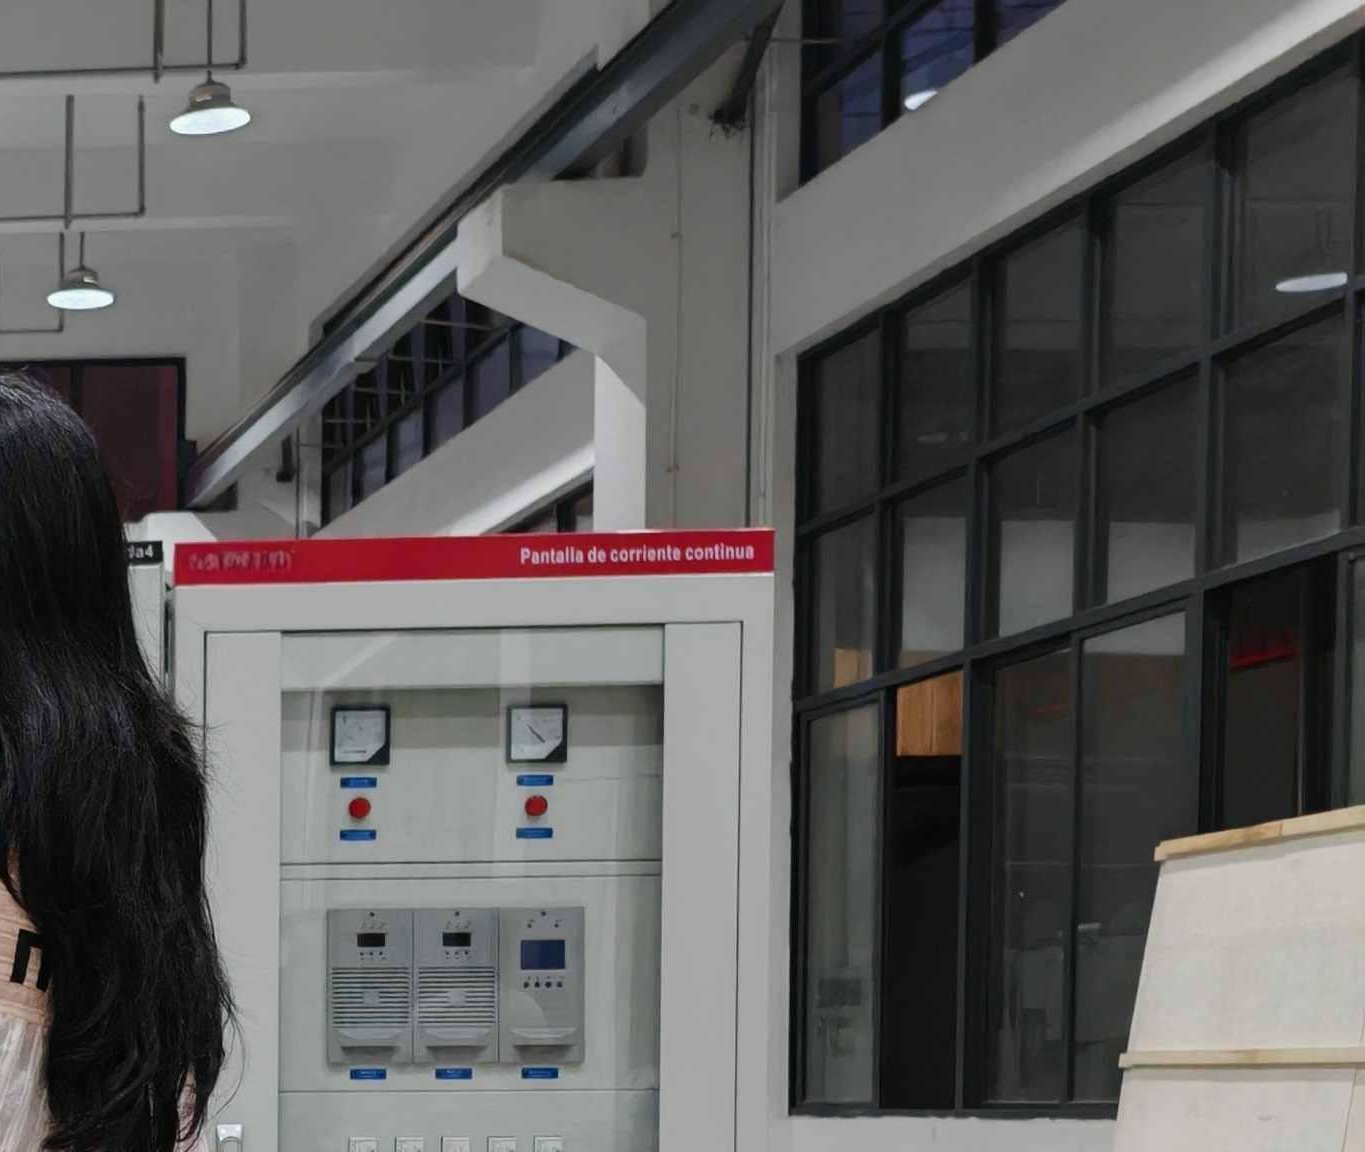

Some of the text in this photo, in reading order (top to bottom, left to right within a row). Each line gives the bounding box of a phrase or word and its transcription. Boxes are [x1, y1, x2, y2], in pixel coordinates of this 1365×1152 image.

[520, 543, 755, 565] Pantalla de corriente continua
